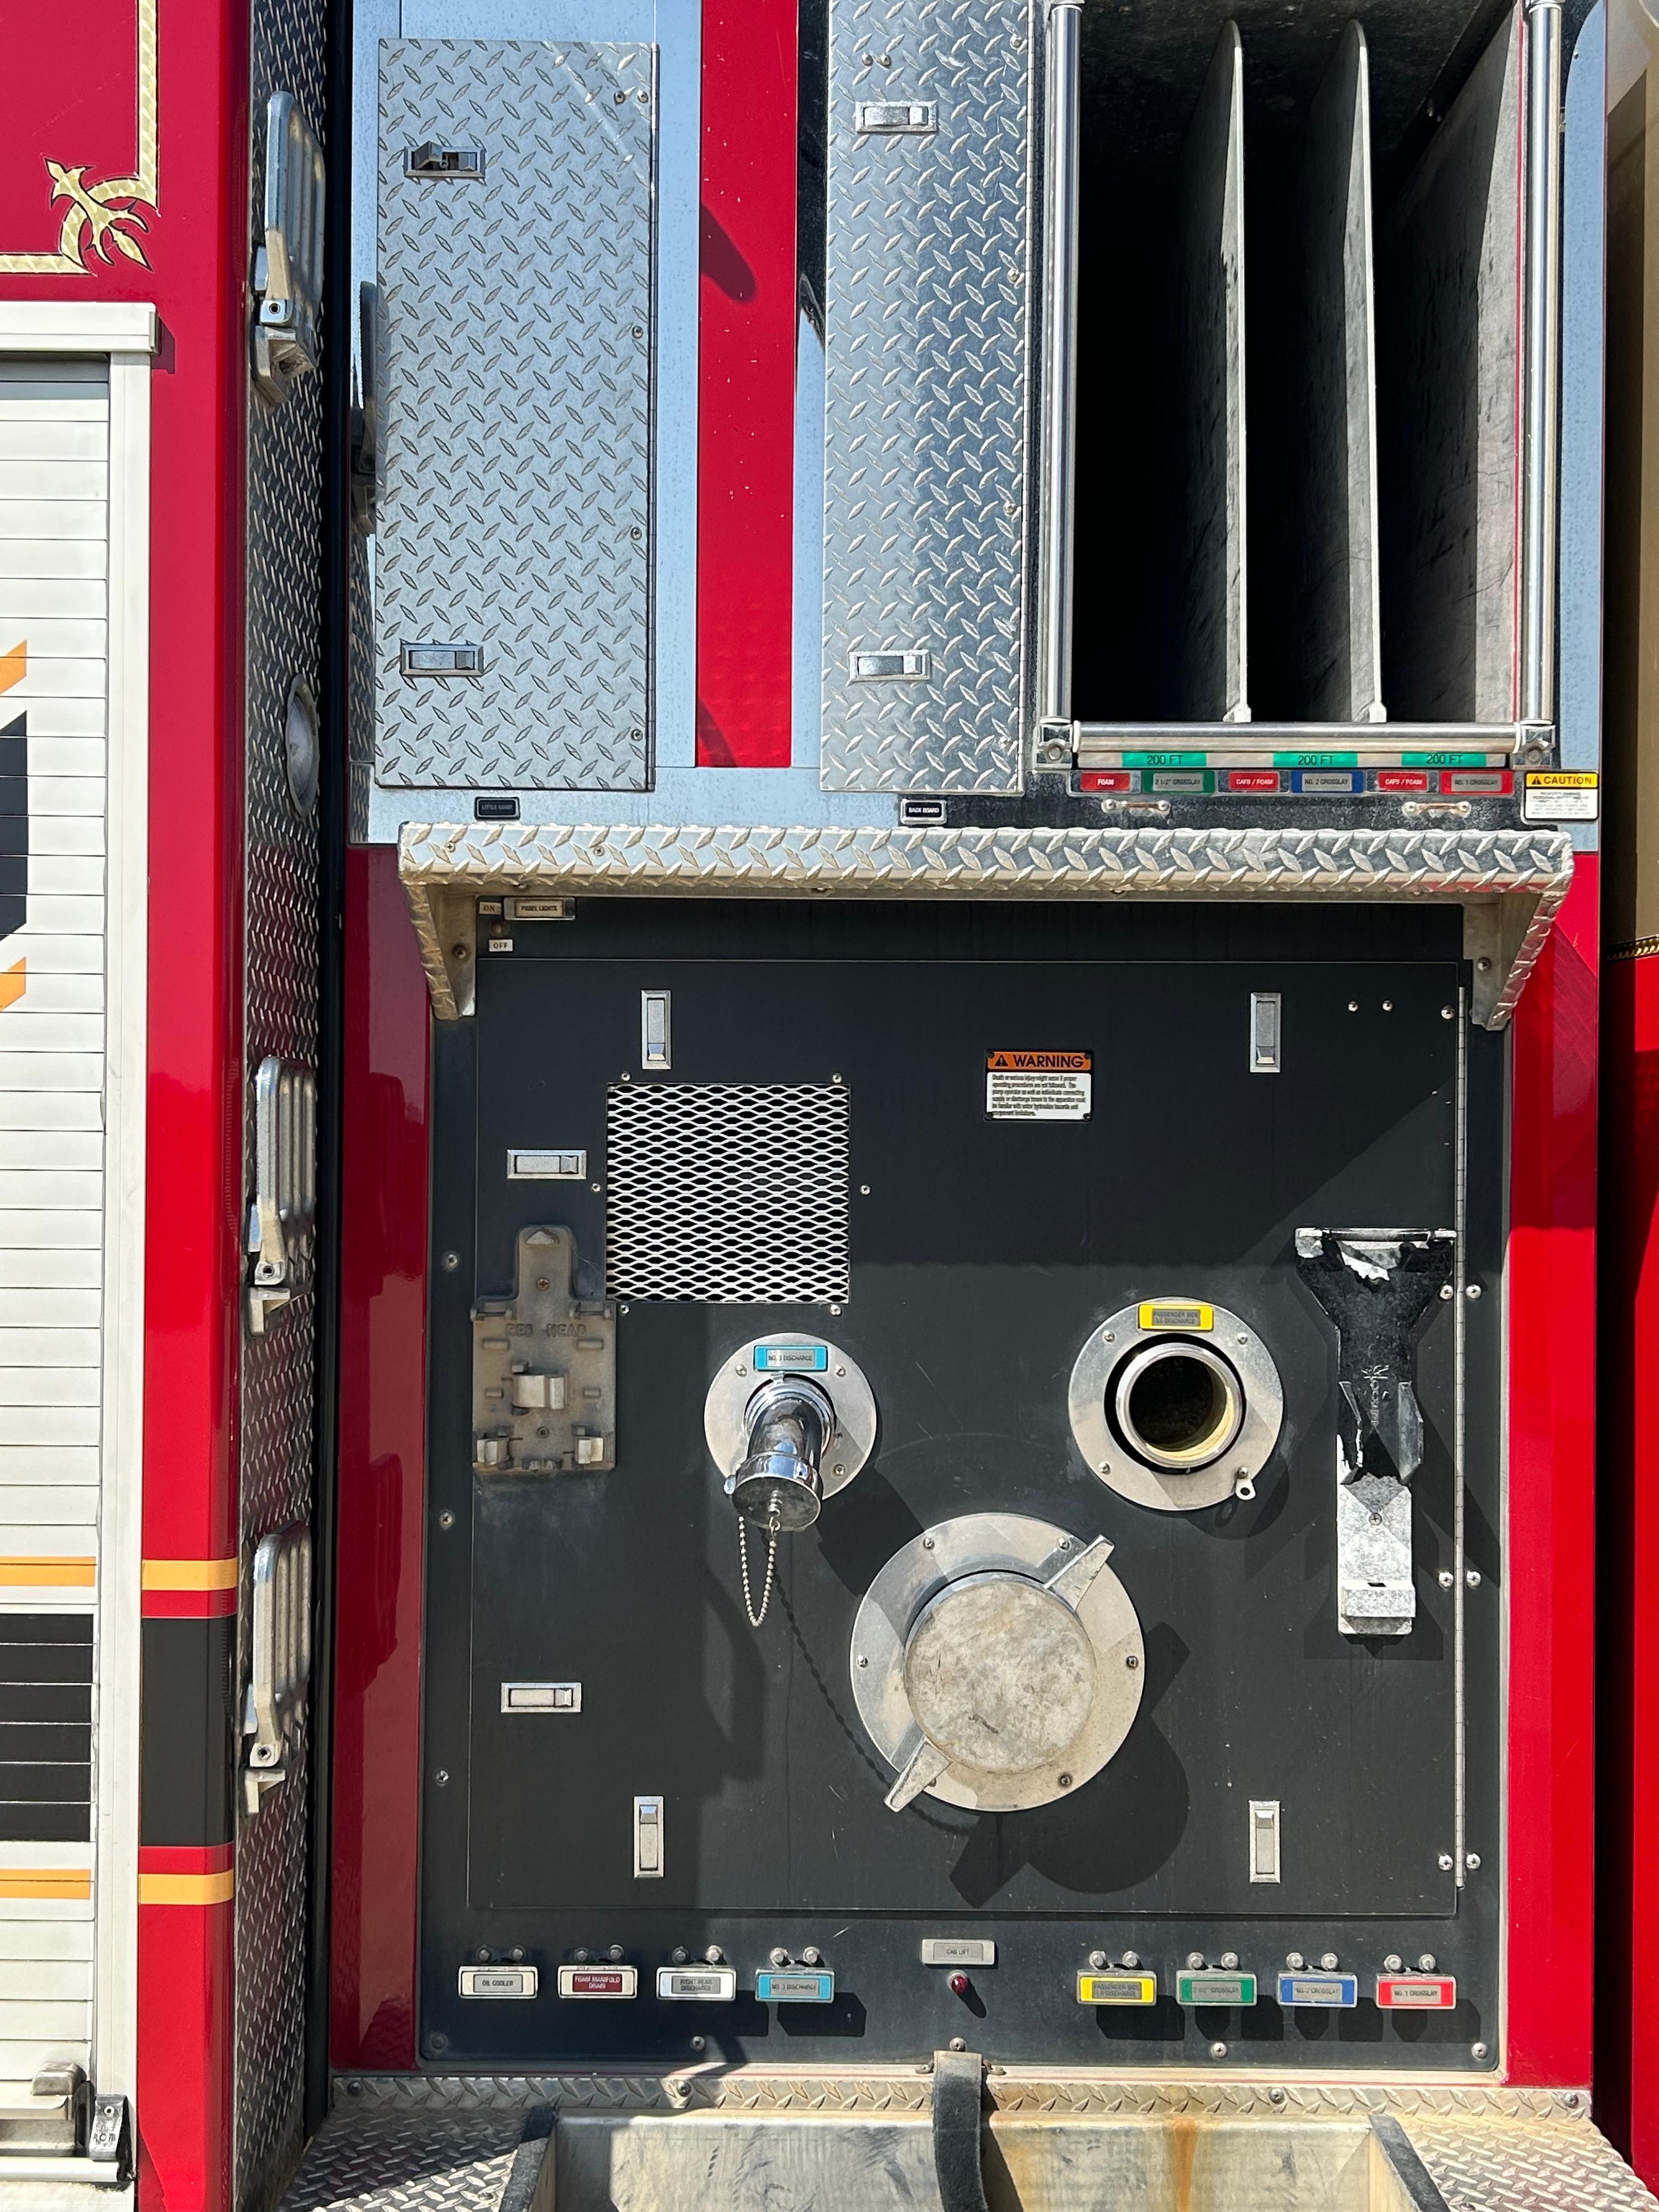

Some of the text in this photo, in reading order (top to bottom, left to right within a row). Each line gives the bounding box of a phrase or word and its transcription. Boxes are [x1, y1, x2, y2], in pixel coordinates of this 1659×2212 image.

[1146, 755, 1182, 765] 200 FT
[1298, 755, 1334, 765] 200 FT
[1426, 754, 1462, 764] 200 FT
[1543, 776, 1592, 784] CAUTION
[1013, 1055, 1084, 1067] WARNING
[505, 1323, 587, 1337] RED HEAD
[93, 2133, 116, 2144] ROM
